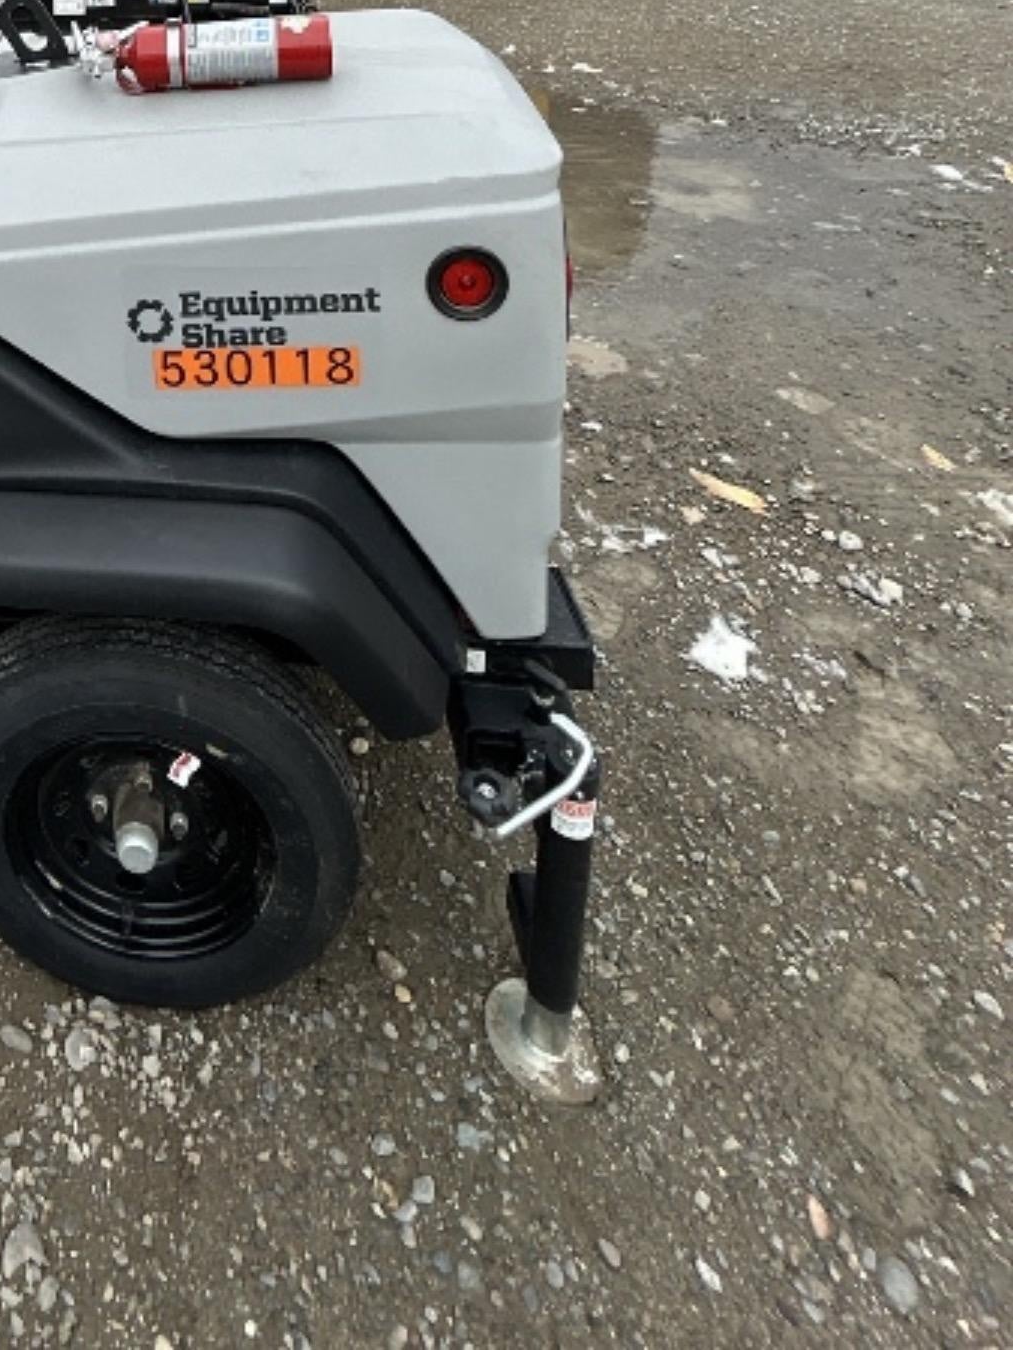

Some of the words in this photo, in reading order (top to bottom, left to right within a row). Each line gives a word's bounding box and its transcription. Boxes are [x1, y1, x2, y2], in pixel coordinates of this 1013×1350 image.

[178, 287, 381, 321] Equipment
[181, 322, 287, 348] Share
[159, 347, 355, 388] 530118
